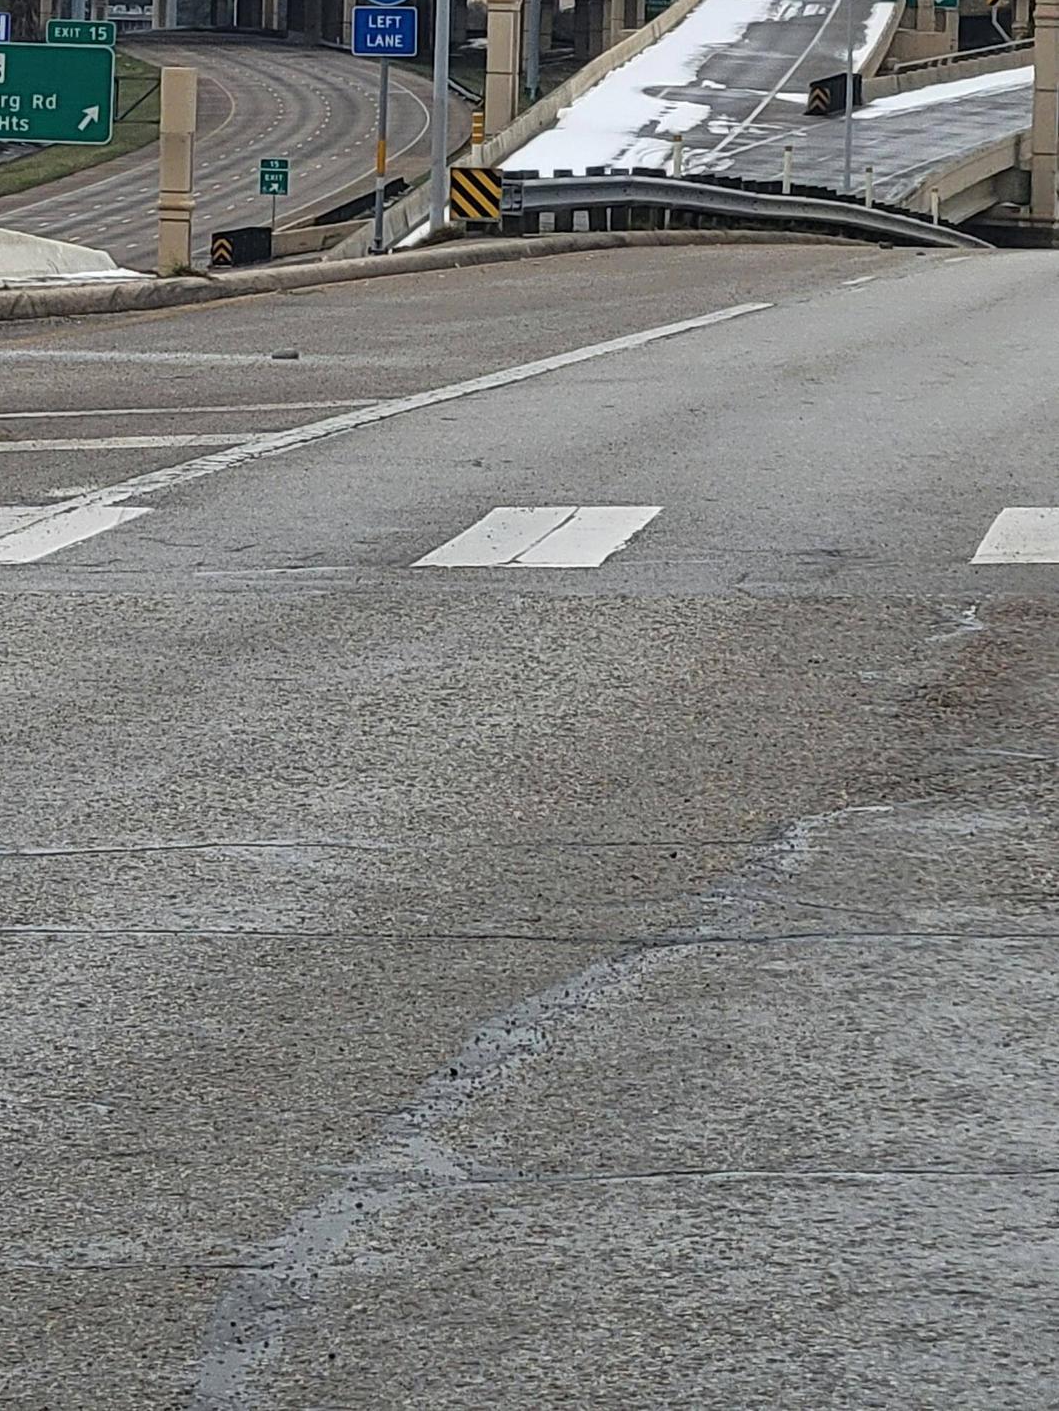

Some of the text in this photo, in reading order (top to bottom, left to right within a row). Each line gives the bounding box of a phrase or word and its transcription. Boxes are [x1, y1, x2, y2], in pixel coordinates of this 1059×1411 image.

[368, 15, 403, 29] LEFT
[54, 26, 108, 41] EXIT 15
[366, 34, 404, 48] LANE
[32, 93, 58, 110] Rd
[270, 160, 279, 168] 15
